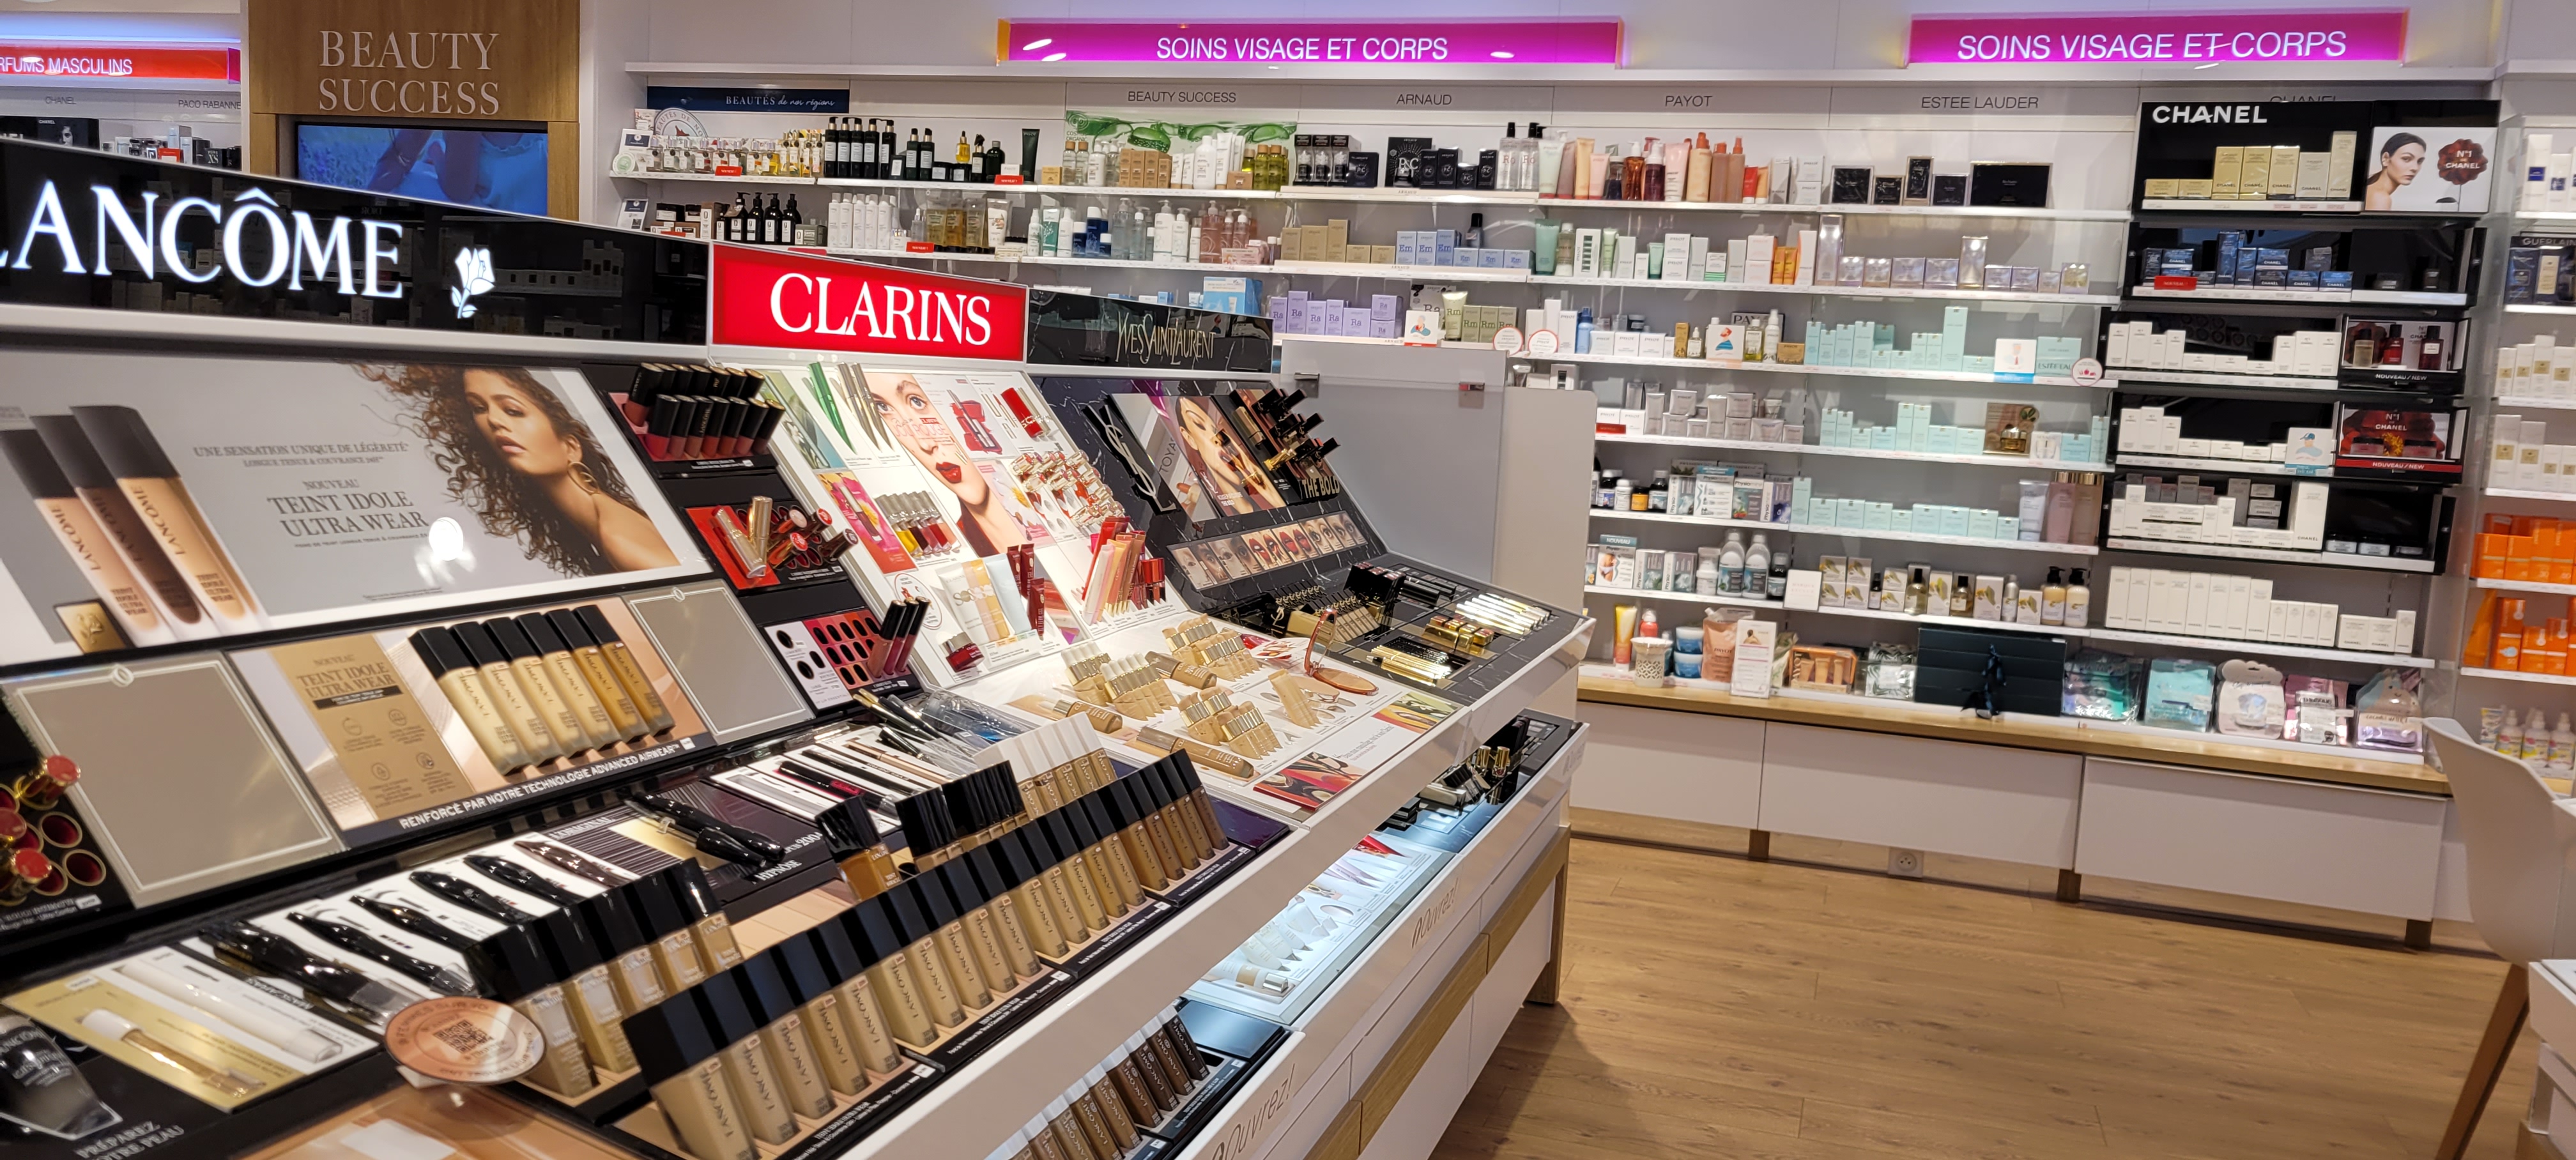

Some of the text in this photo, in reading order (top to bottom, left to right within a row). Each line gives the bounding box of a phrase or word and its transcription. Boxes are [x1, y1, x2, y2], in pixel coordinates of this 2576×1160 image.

[320, 31, 499, 71] BEAUTY
[1156, 38, 1448, 60] SOINS VISAGE ET CORPS
[1958, 31, 2347, 60] SOINS VISAGE ET CORPS
[49, 57, 133, 75] MASCULINS
[319, 78, 500, 115] SUCCESS
[726, 95, 775, 105] BEAUTÉS
[1128, 91, 1236, 103] BEAUTY SUCCESS
[1397, 94, 1452, 105] ARNAUD
[1665, 96, 1712, 107] PAYOT
[178, 100, 201, 109] PACO
[1921, 96, 2039, 109] ESTEE LAUDER
[2152, 105, 2267, 123] CHANEL
[1503, 155, 1516, 165] Ro
[1522, 155, 1536, 165] Ro
[2446, 161, 2480, 171] CHANEL
[0, 181, 403, 300] ANCÔME
[1399, 245, 1413, 253] Em
[1419, 245, 1433, 253] Em
[770, 273, 991, 346] CLARINS
[1292, 309, 1302, 317] Ra
[1447, 309, 1462, 317] Rm
[1311, 314, 1321, 323] Ra
[1329, 314, 1339, 323] Ra
[1351, 319, 1361, 327] Ra
[1463, 320, 1478, 328] Rm
[1481, 321, 1496, 329] Rm
[303, 479, 360, 490] NOUVEAU
[1301, 475, 1340, 498] THE BOLD
[267, 491, 414, 514] TEINT IDOLE
[280, 512, 429, 537] ULTRA WEAR
[297, 662, 389, 687] TEINT IDOLE
[305, 682, 355, 699] ULTRA
[353, 674, 396, 691] WEAR
[399, 802, 463, 830] RENFORCÉ
[462, 795, 487, 813] PAR
[487, 786, 525, 809] NOTRE
[521, 767, 592, 798] TECHNOLOGIE
[590, 754, 639, 779] ADVANCED
